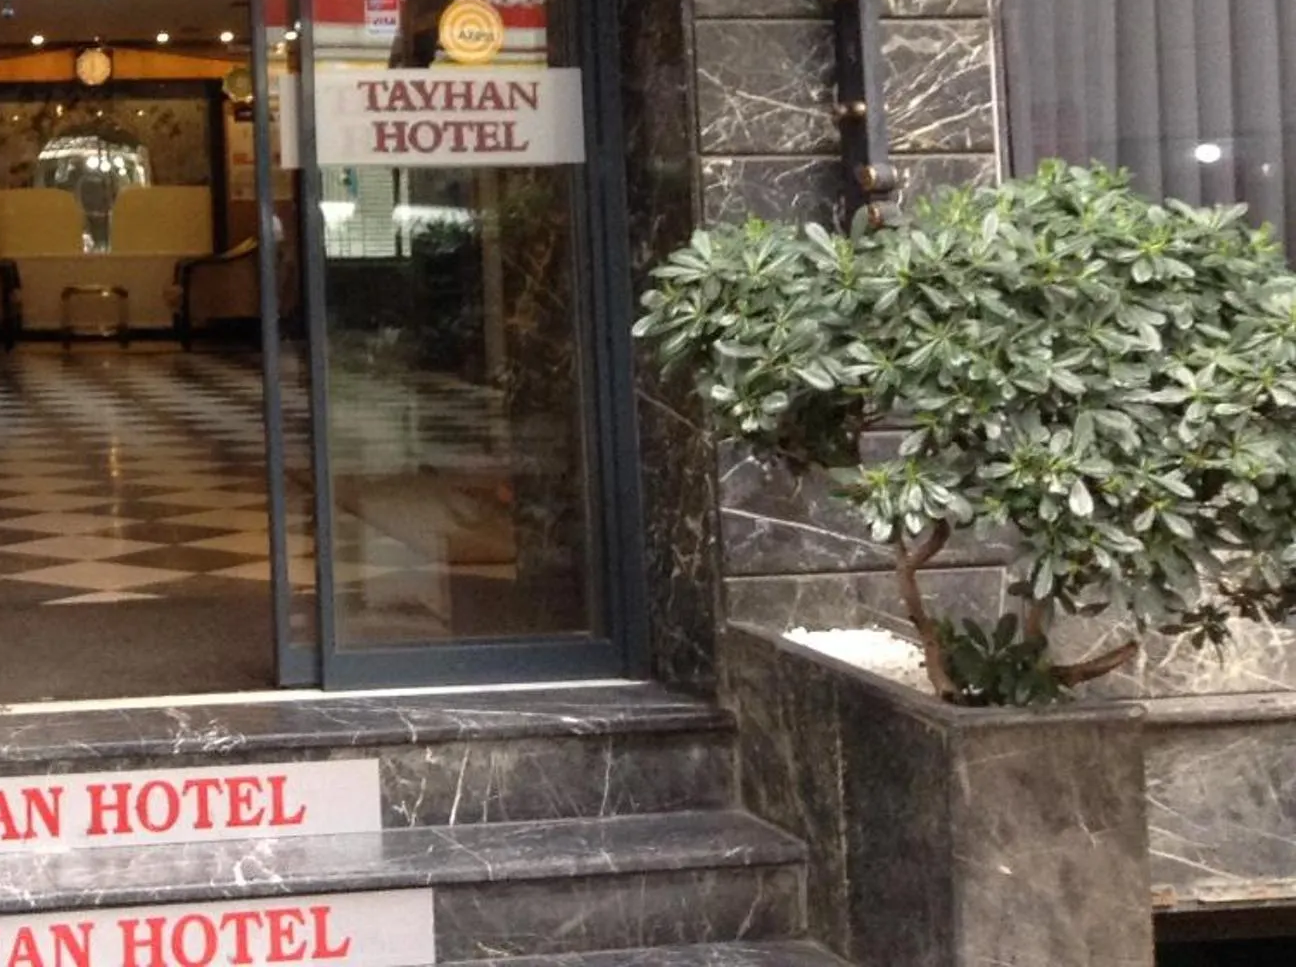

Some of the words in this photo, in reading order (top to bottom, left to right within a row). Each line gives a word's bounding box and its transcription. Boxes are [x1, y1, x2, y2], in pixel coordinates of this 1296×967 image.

[357, 79, 540, 112] TAYHAN
[372, 120, 529, 153] HOTEL
[87, 774, 306, 837] HOTEL
[117, 904, 352, 967] HOTEL
